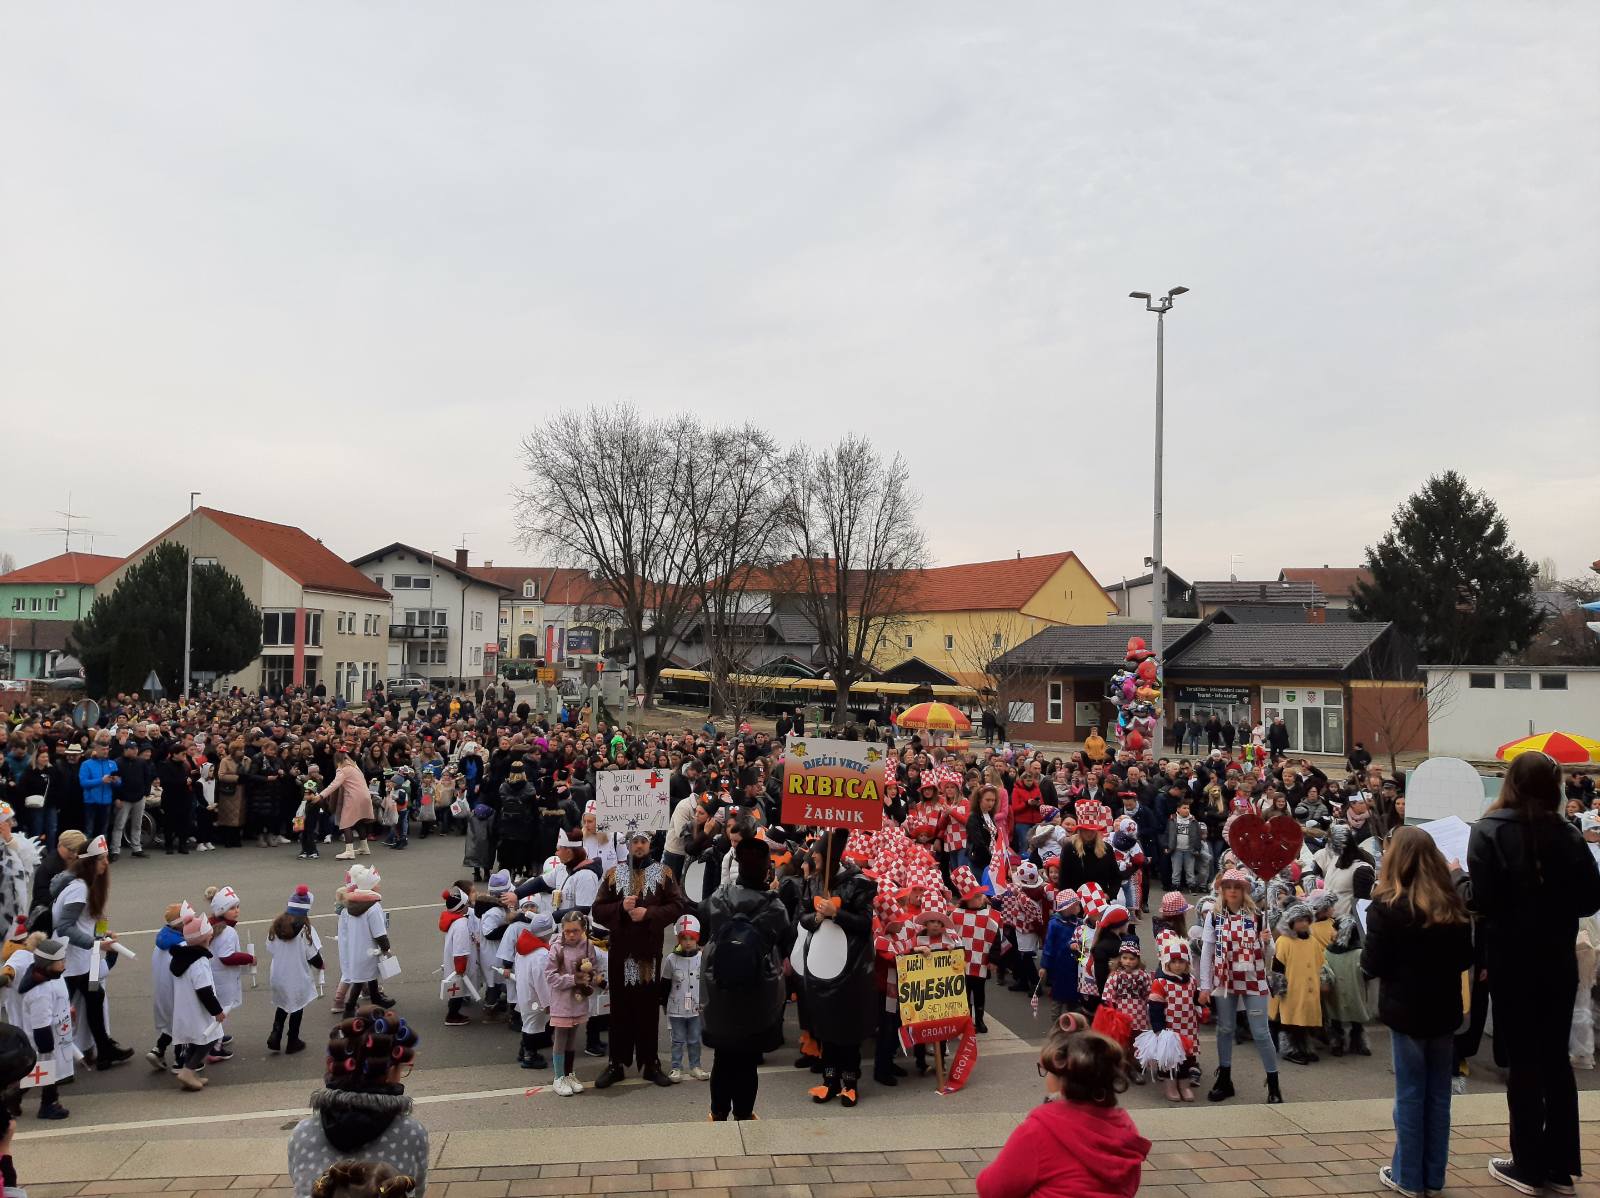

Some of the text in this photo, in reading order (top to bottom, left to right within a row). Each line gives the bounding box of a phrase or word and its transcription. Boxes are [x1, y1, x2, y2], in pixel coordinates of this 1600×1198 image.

[803, 754, 870, 774] DJEČJI VRTIĆ
[788, 773, 879, 800] RIBICA
[804, 804, 864, 823] ŽABNIK
[921, 1025, 957, 1038] CROATIA
[952, 1036, 976, 1080] CROATIA
